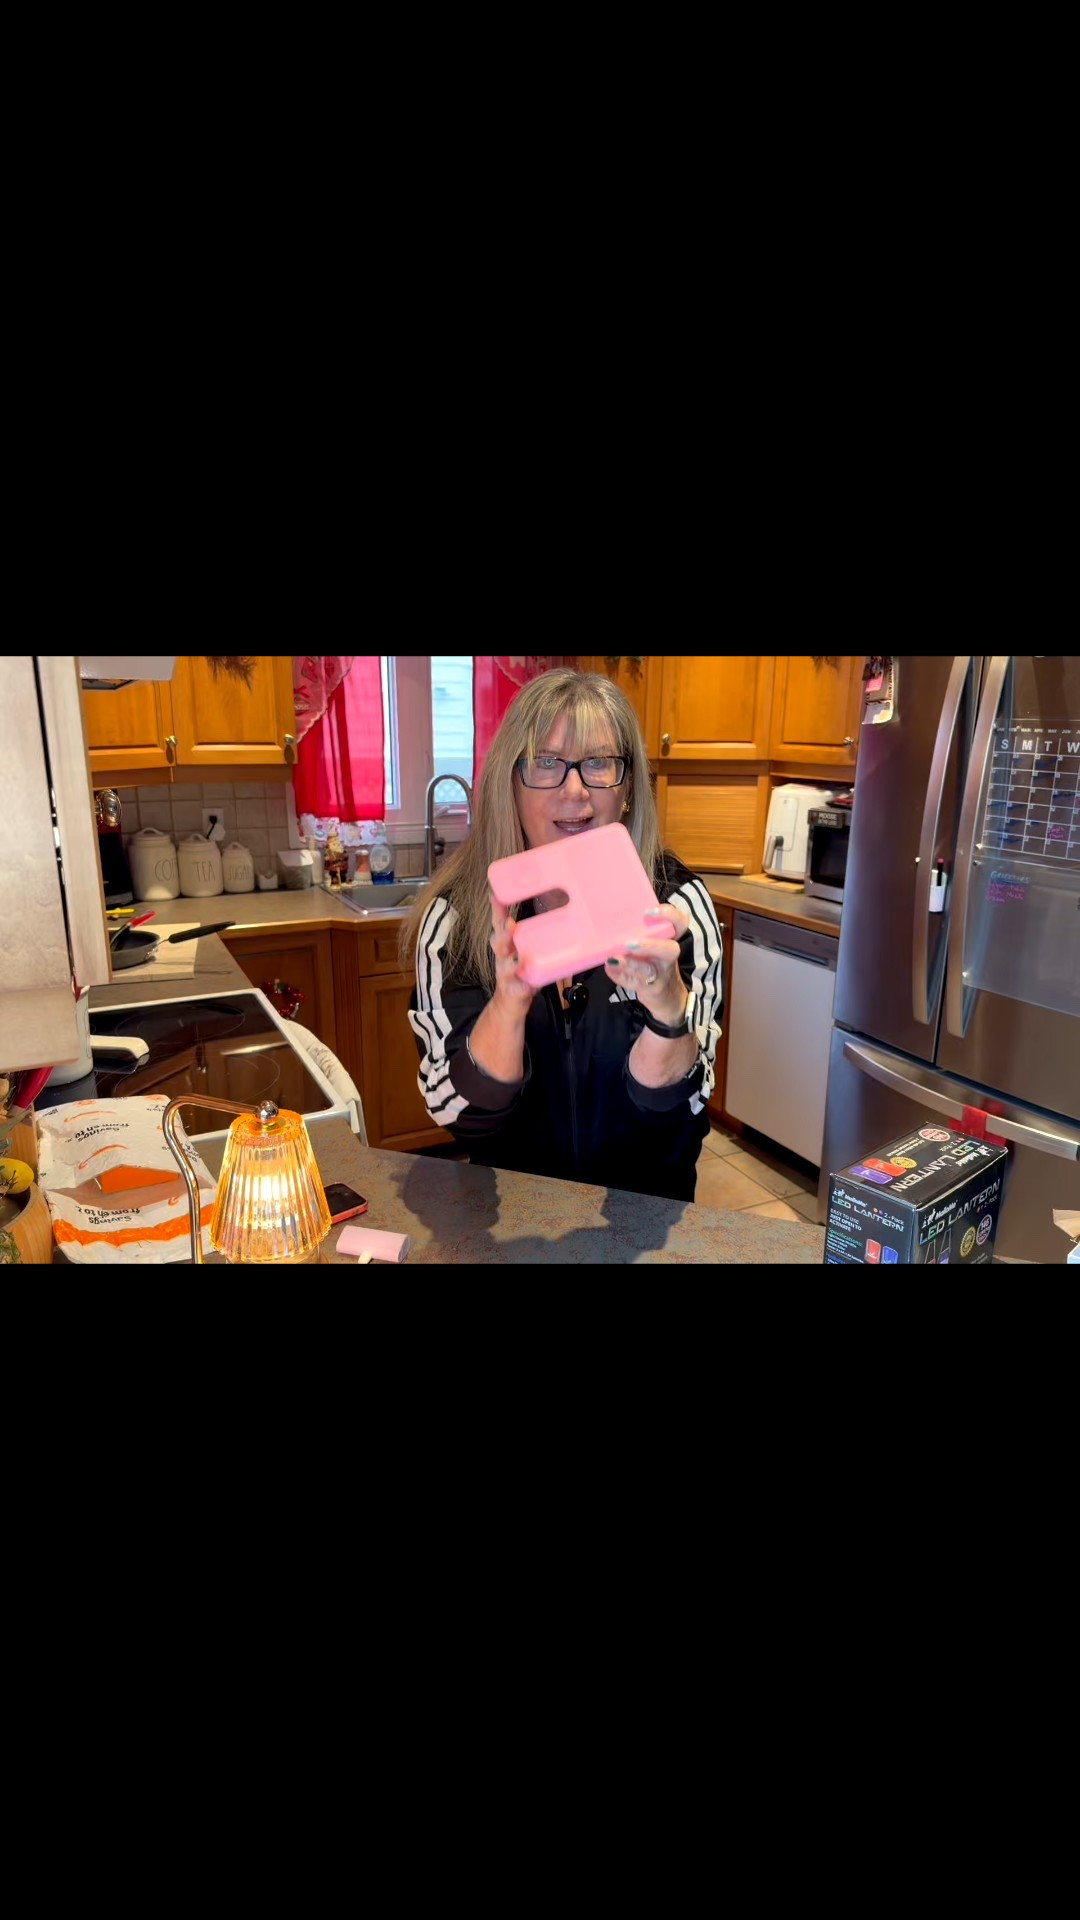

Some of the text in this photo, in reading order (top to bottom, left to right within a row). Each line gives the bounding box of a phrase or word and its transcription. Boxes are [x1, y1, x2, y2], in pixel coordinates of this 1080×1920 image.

[1001, 738, 1080, 753] S M T W
[192, 860, 216, 882] TEA
[951, 1139, 981, 1156] LED
[889, 1154, 957, 1192] LANTERN
[84, 1208, 95, 1217] to
[88, 1215, 132, 1225] Savings
[111, 1207, 141, 1216] from
[831, 1195, 851, 1209] LED
[853, 1205, 905, 1232] LANTERN
[920, 1219, 945, 1245] LED
[948, 1178, 1000, 1226] LANTERN
[829, 1213, 862, 1231] JUST OPEN TO
[829, 1219, 852, 1232] ACTIVATE
